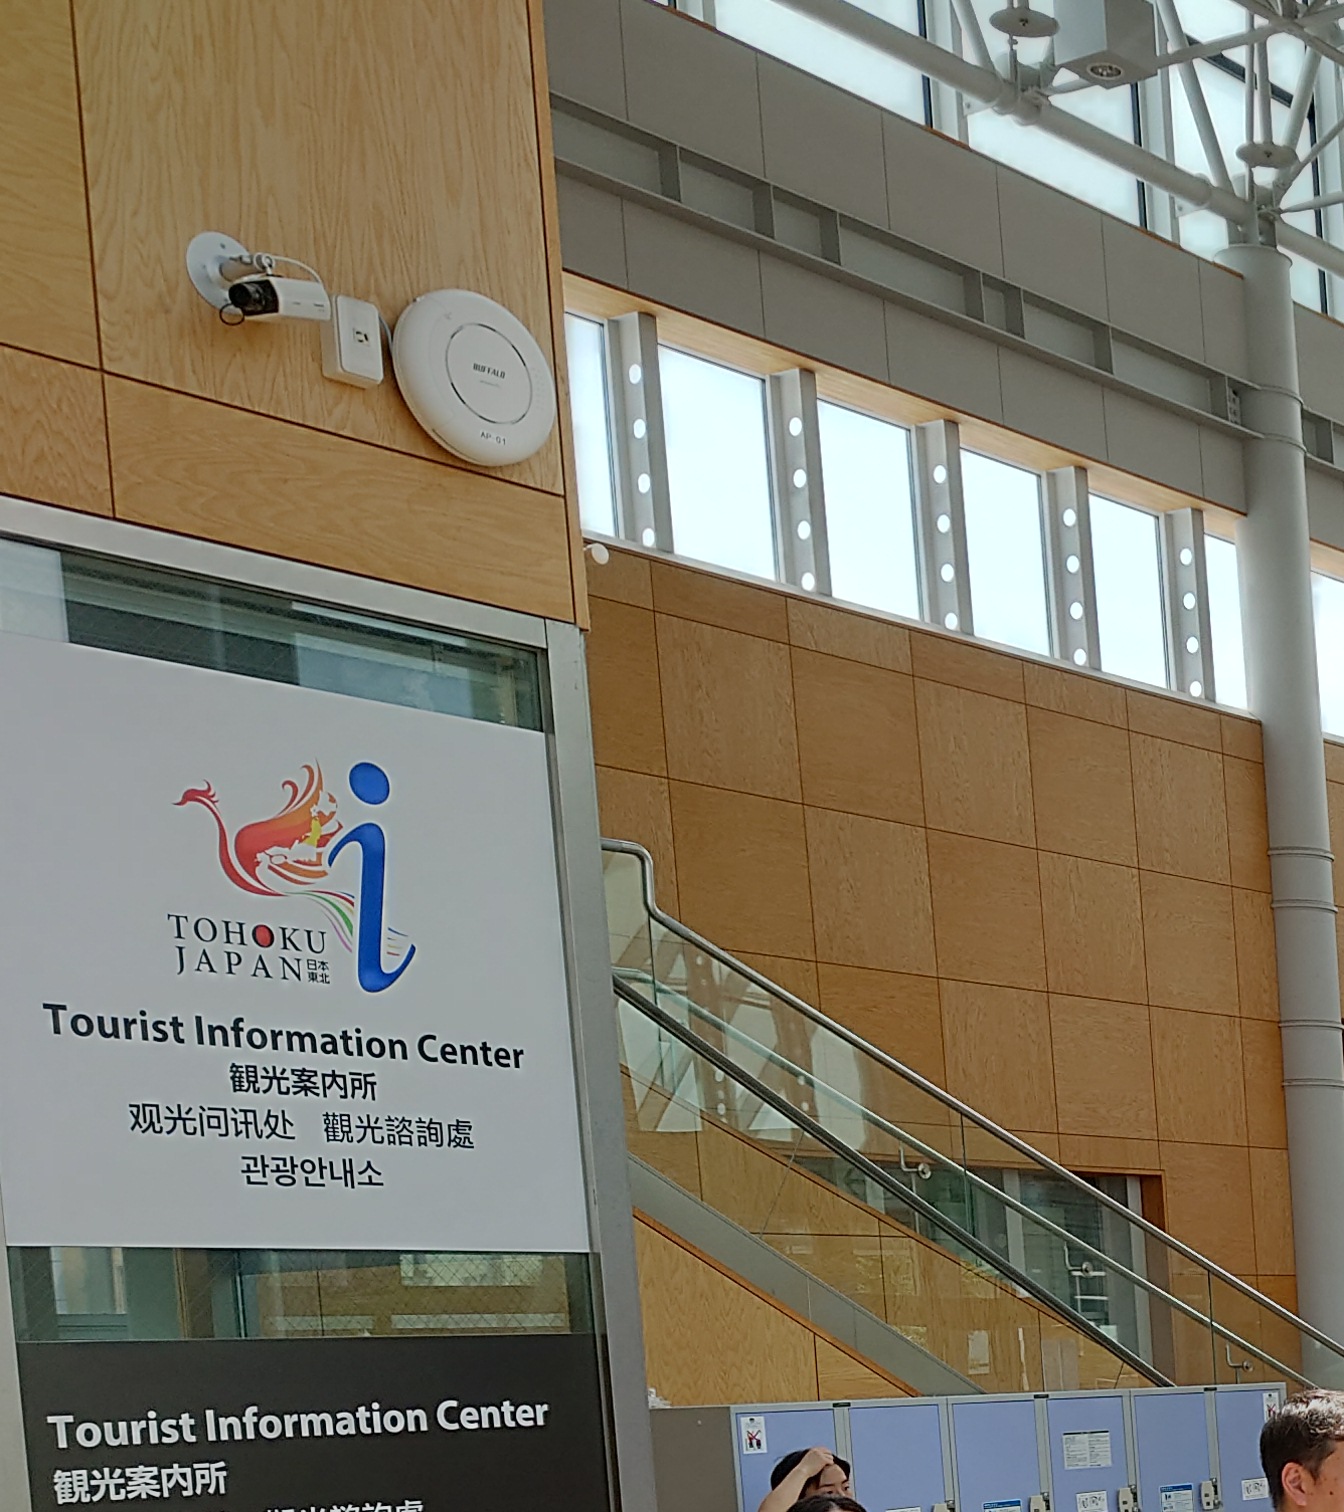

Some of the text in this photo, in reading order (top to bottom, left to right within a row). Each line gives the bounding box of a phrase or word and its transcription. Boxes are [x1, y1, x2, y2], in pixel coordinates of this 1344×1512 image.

[473, 363, 506, 379] BUFFALO
[167, 914, 327, 955] TOHOKU
[175, 946, 302, 981] JAPAN
[307, 959, 329, 972] 日本
[43, 1003, 524, 1070] Tourist Information Center
[229, 1061, 378, 1102] 観光案内所
[129, 1102, 476, 1150] 观光问讯处 觀光諮詢處
[240, 1154, 385, 1190] 관광안내소
[47, 1399, 549, 1449] Tourist Information Center
[53, 1461, 228, 1504] 観光案内所
